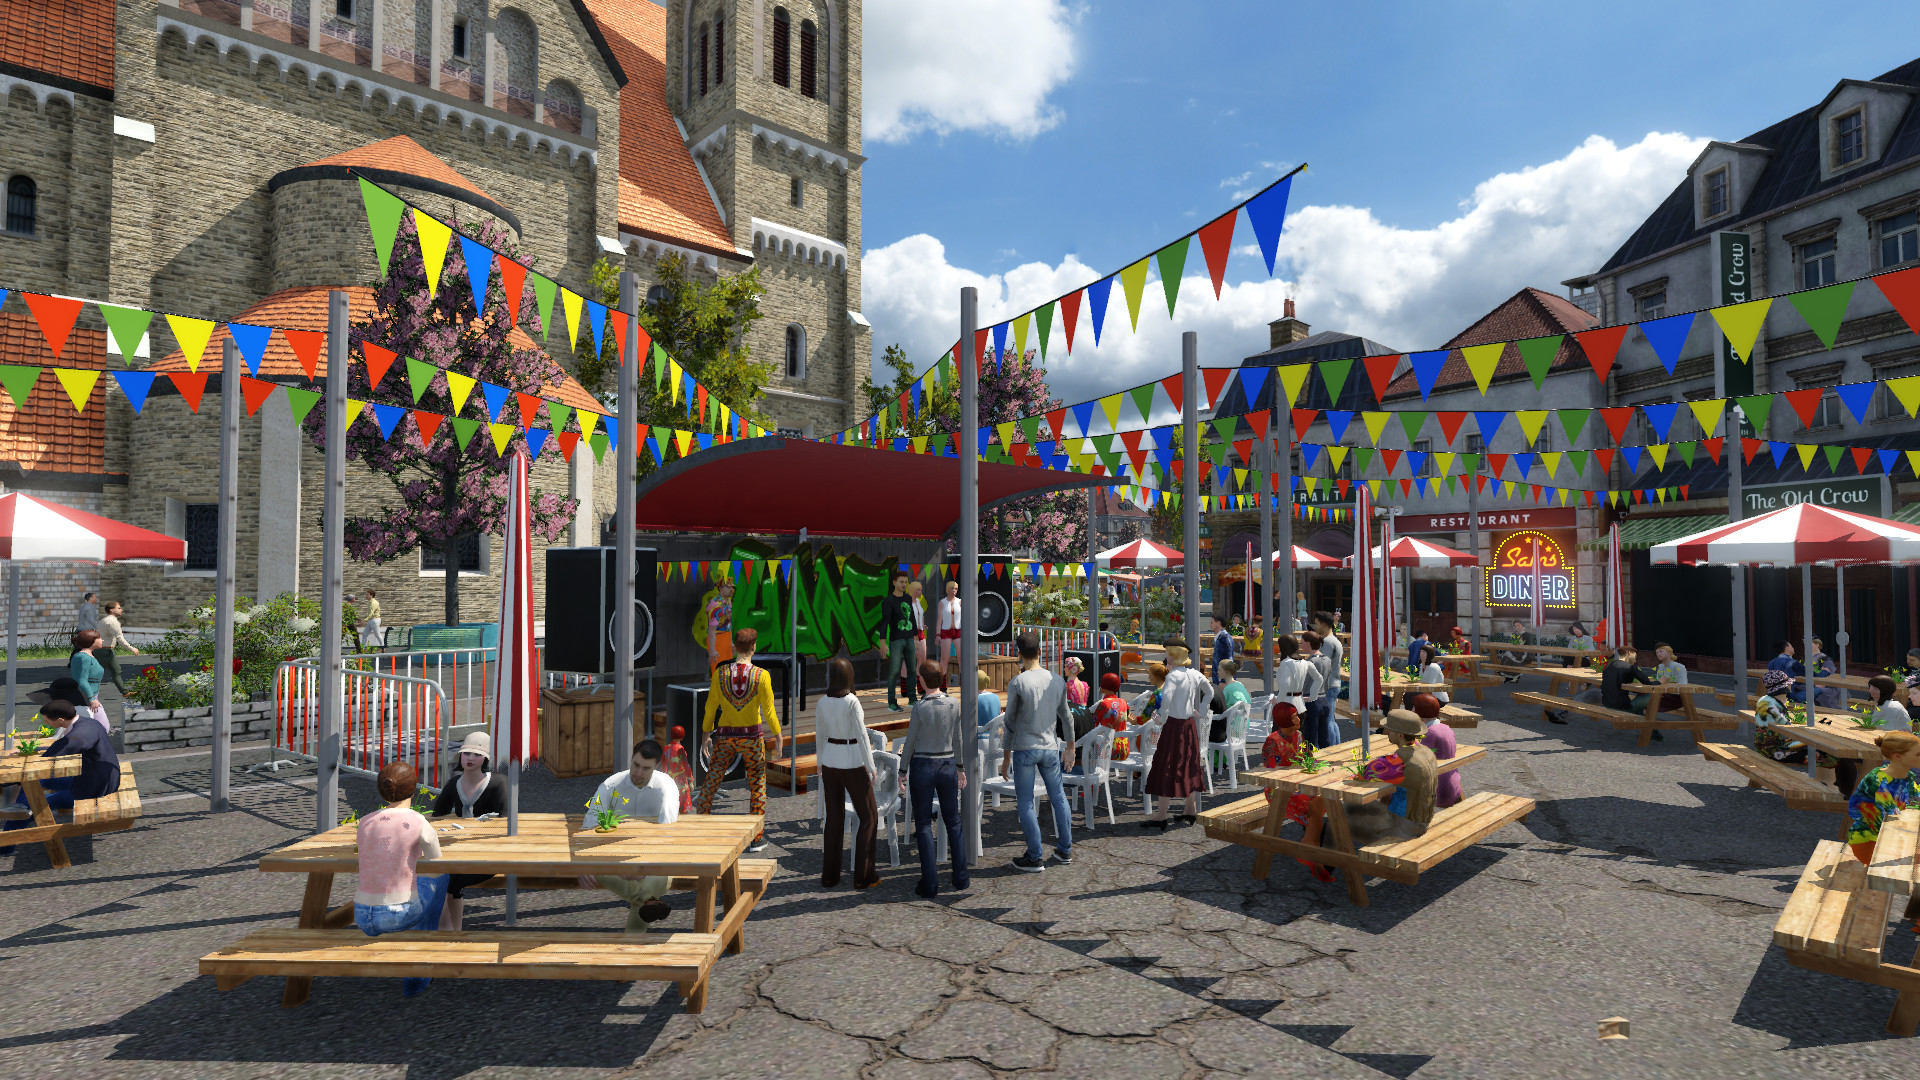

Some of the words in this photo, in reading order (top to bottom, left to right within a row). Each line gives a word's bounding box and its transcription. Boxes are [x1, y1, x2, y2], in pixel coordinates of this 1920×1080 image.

[1728, 243, 1745, 286] Crow
[1745, 493, 1776, 510] The
[1780, 489, 1813, 507] Old
[1820, 487, 1869, 505] Crow
[1492, 574, 1570, 601] DINER
